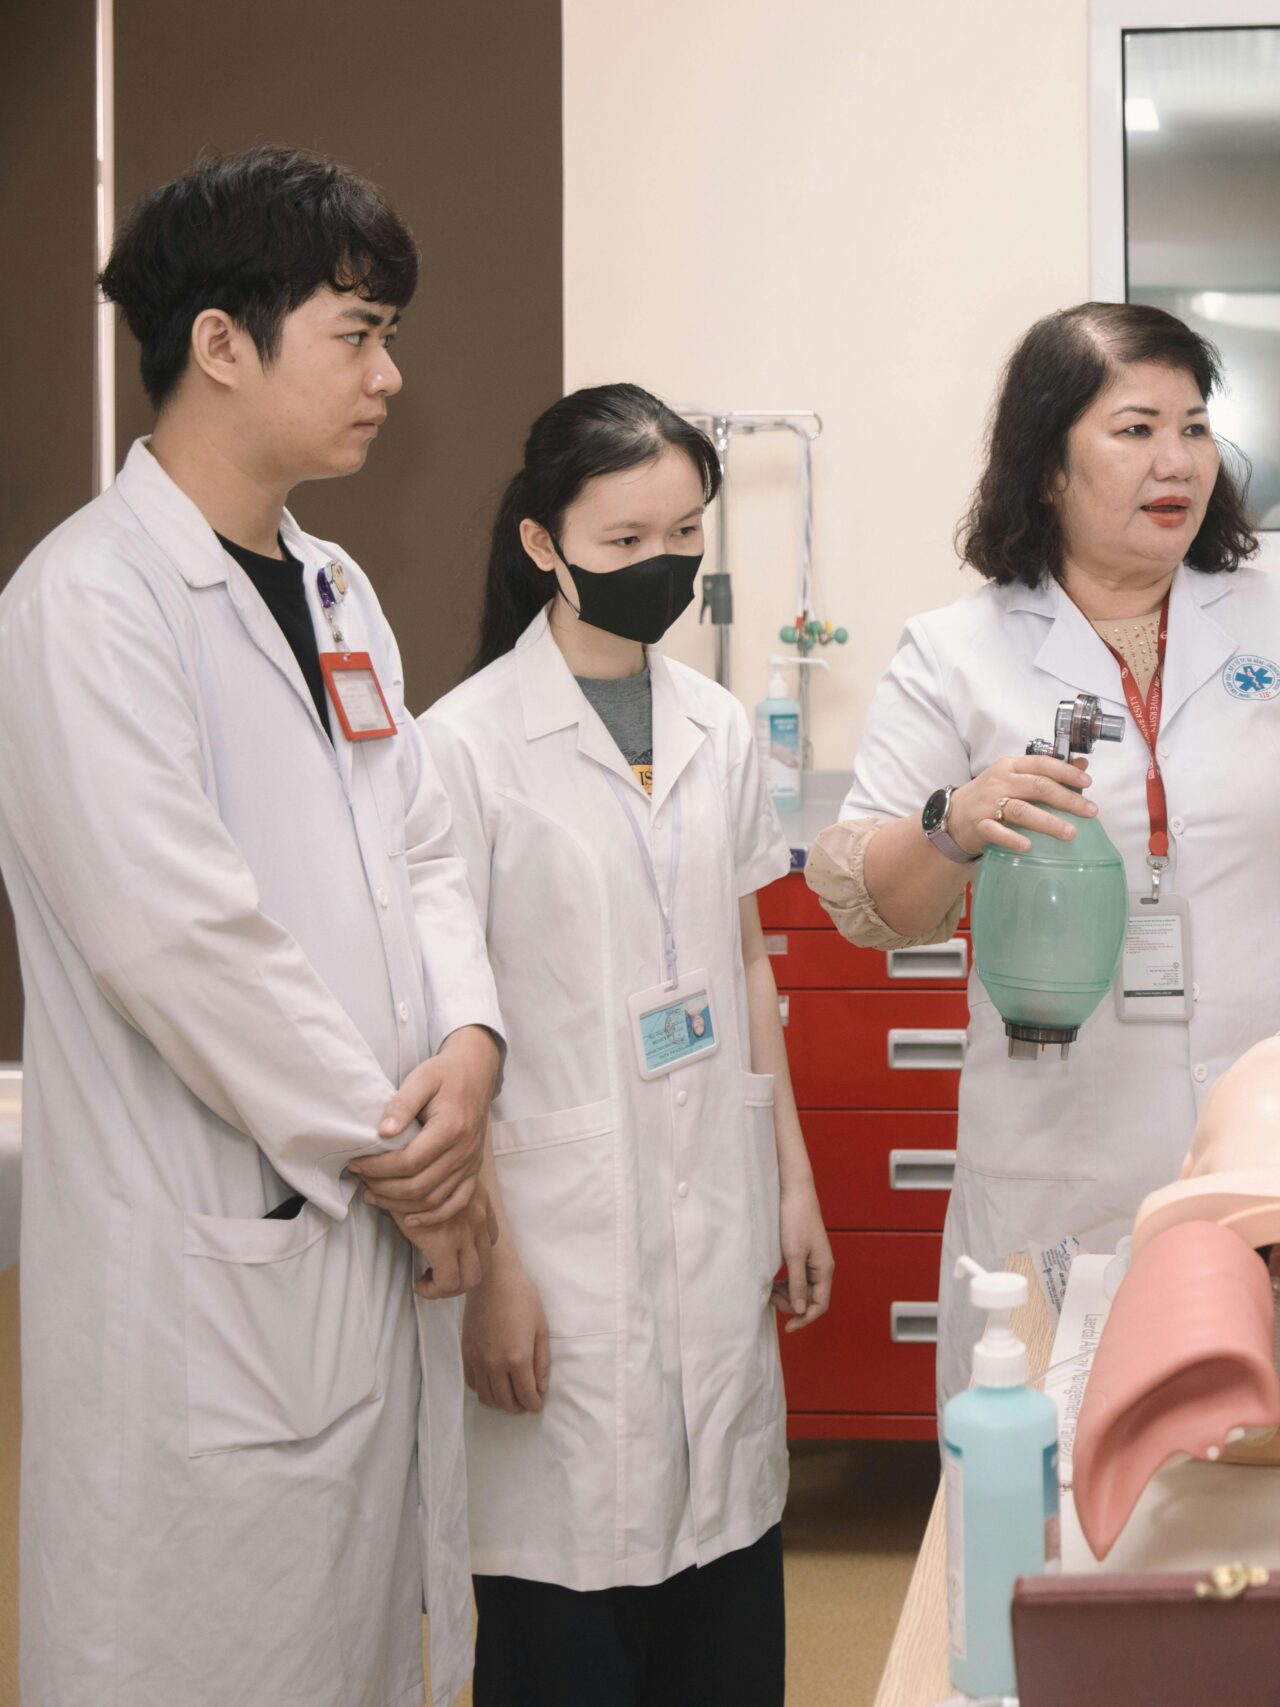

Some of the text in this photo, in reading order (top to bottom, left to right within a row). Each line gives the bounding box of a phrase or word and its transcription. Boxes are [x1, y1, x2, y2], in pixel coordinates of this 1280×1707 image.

[1150, 687, 1161, 733] UNIVERSITY
[1081, 1313, 1104, 1340] Laerdal
[1073, 1340, 1098, 1367] Airay
[1063, 1369, 1091, 1420] Management
